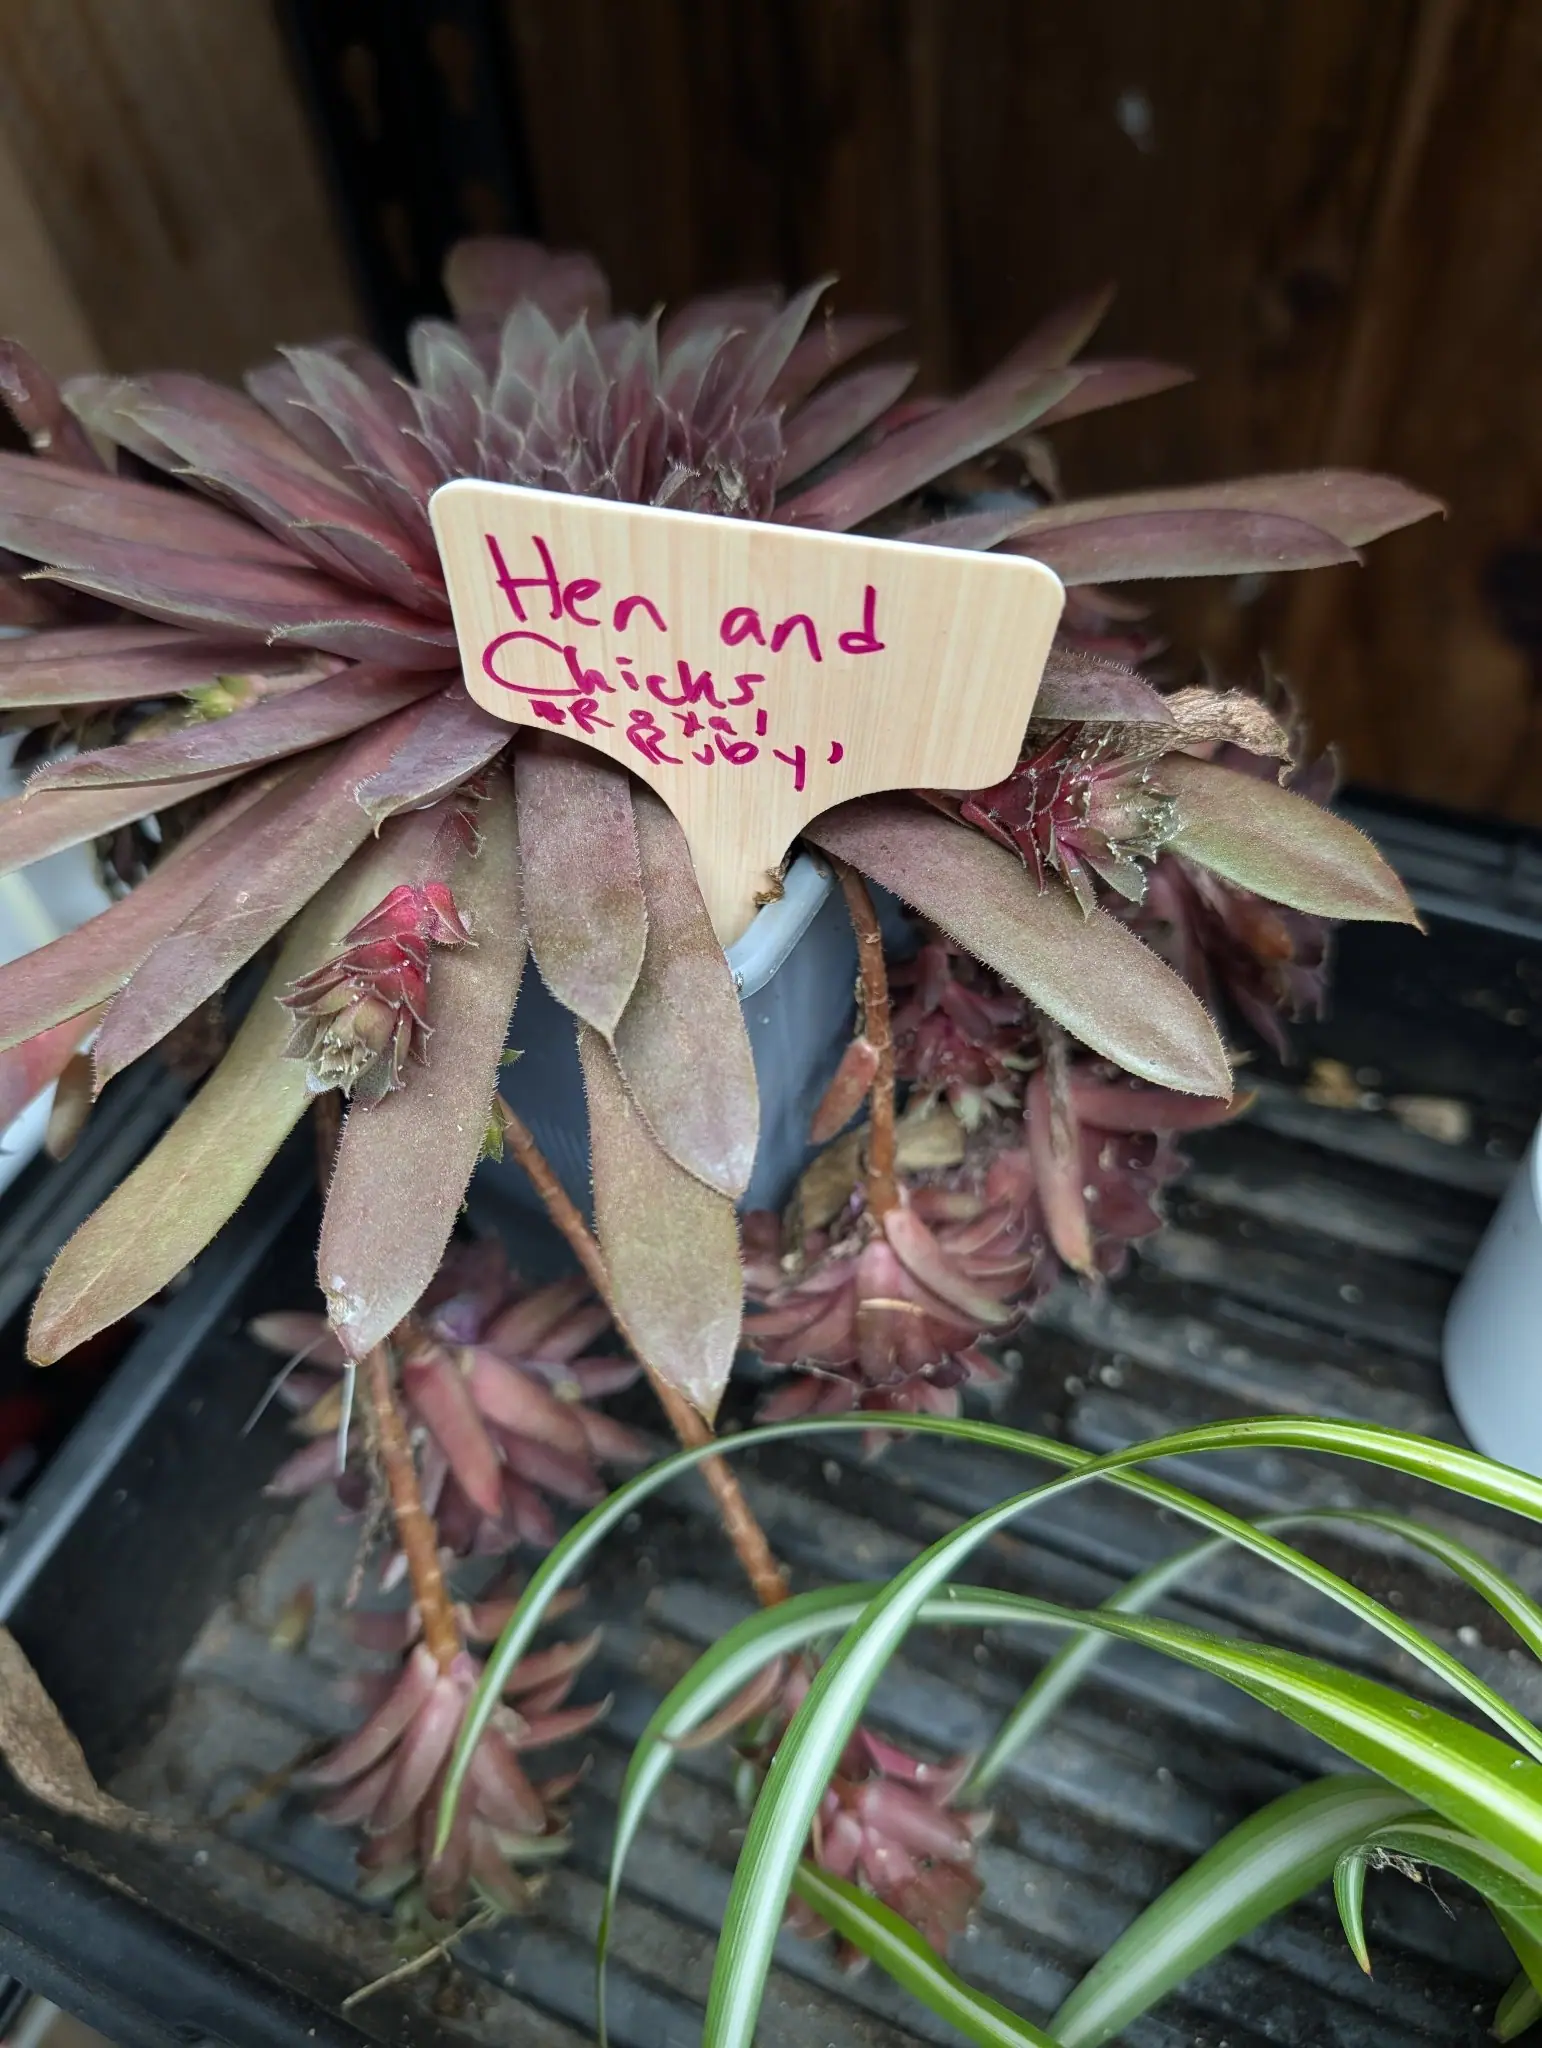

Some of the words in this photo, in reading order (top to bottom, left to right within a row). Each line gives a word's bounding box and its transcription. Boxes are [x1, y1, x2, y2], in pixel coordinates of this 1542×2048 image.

[486, 533, 667, 632] Hen
[719, 585, 885, 663] and
[481, 630, 767, 710] Chicks
